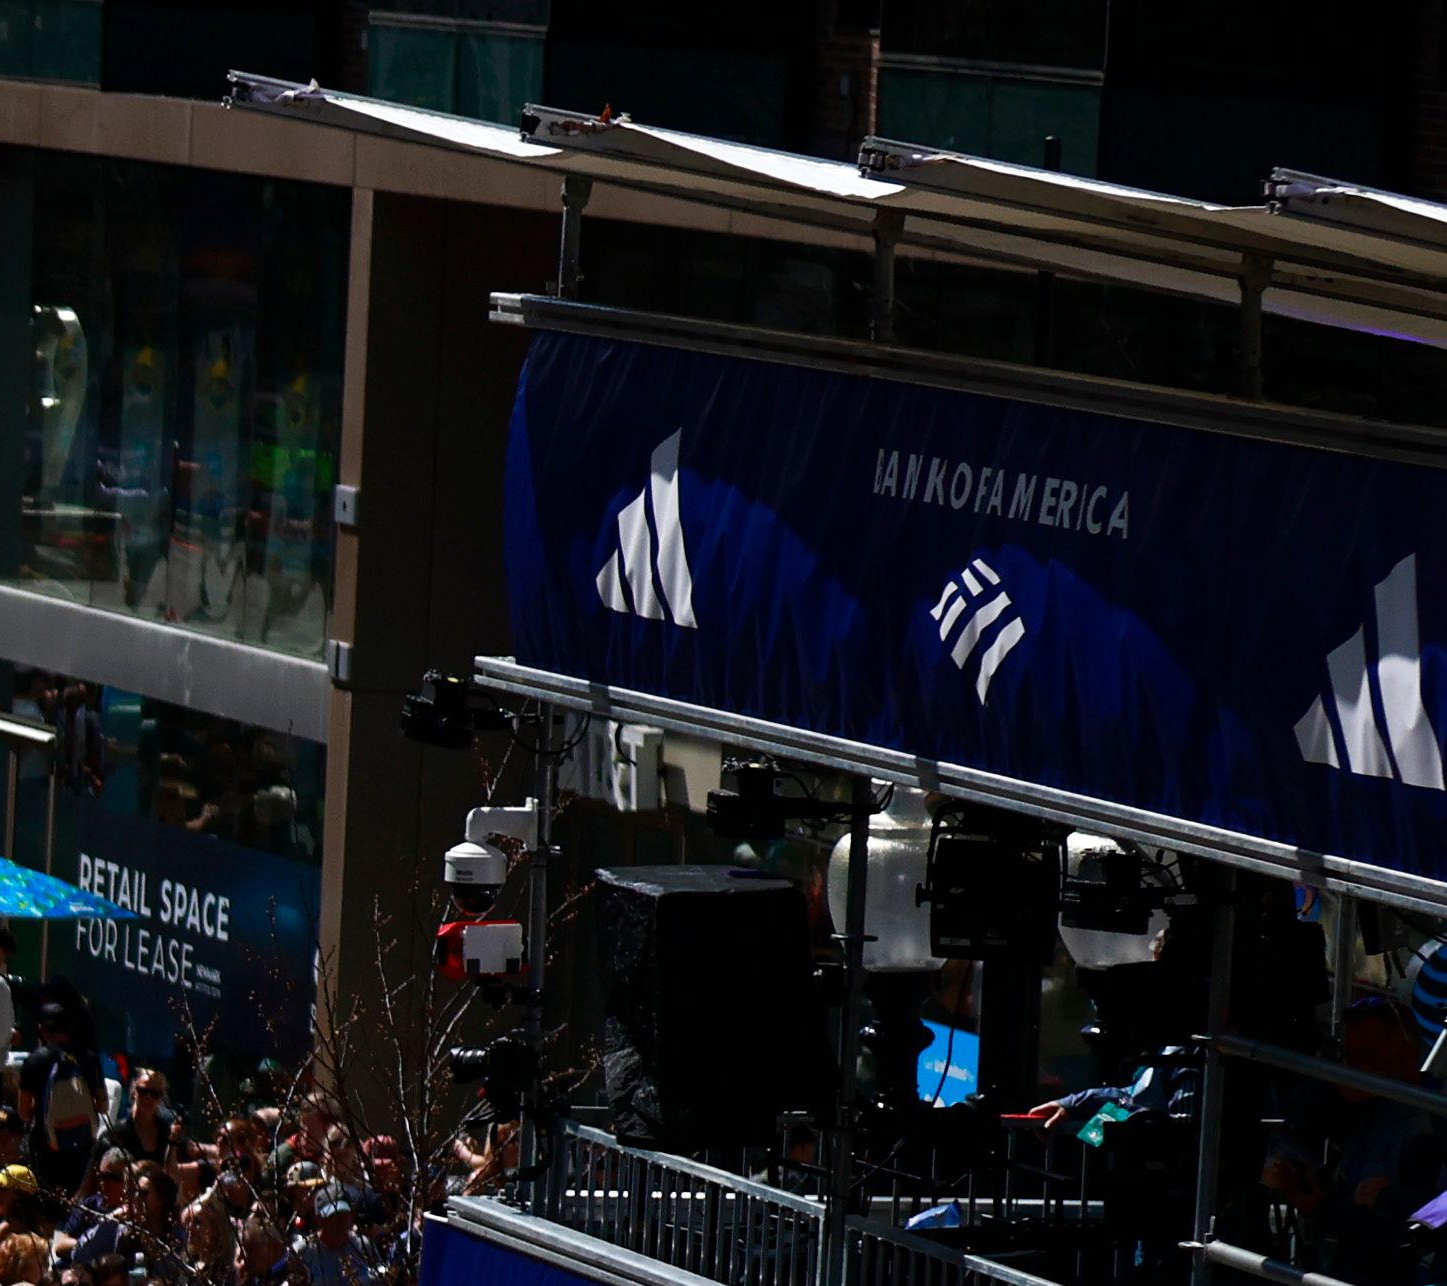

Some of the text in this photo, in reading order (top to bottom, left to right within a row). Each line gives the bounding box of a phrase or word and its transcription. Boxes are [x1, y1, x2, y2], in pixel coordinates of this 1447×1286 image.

[79, 852, 231, 942] RETAIL SPACE
[76, 916, 193, 990] FOR LEASE
